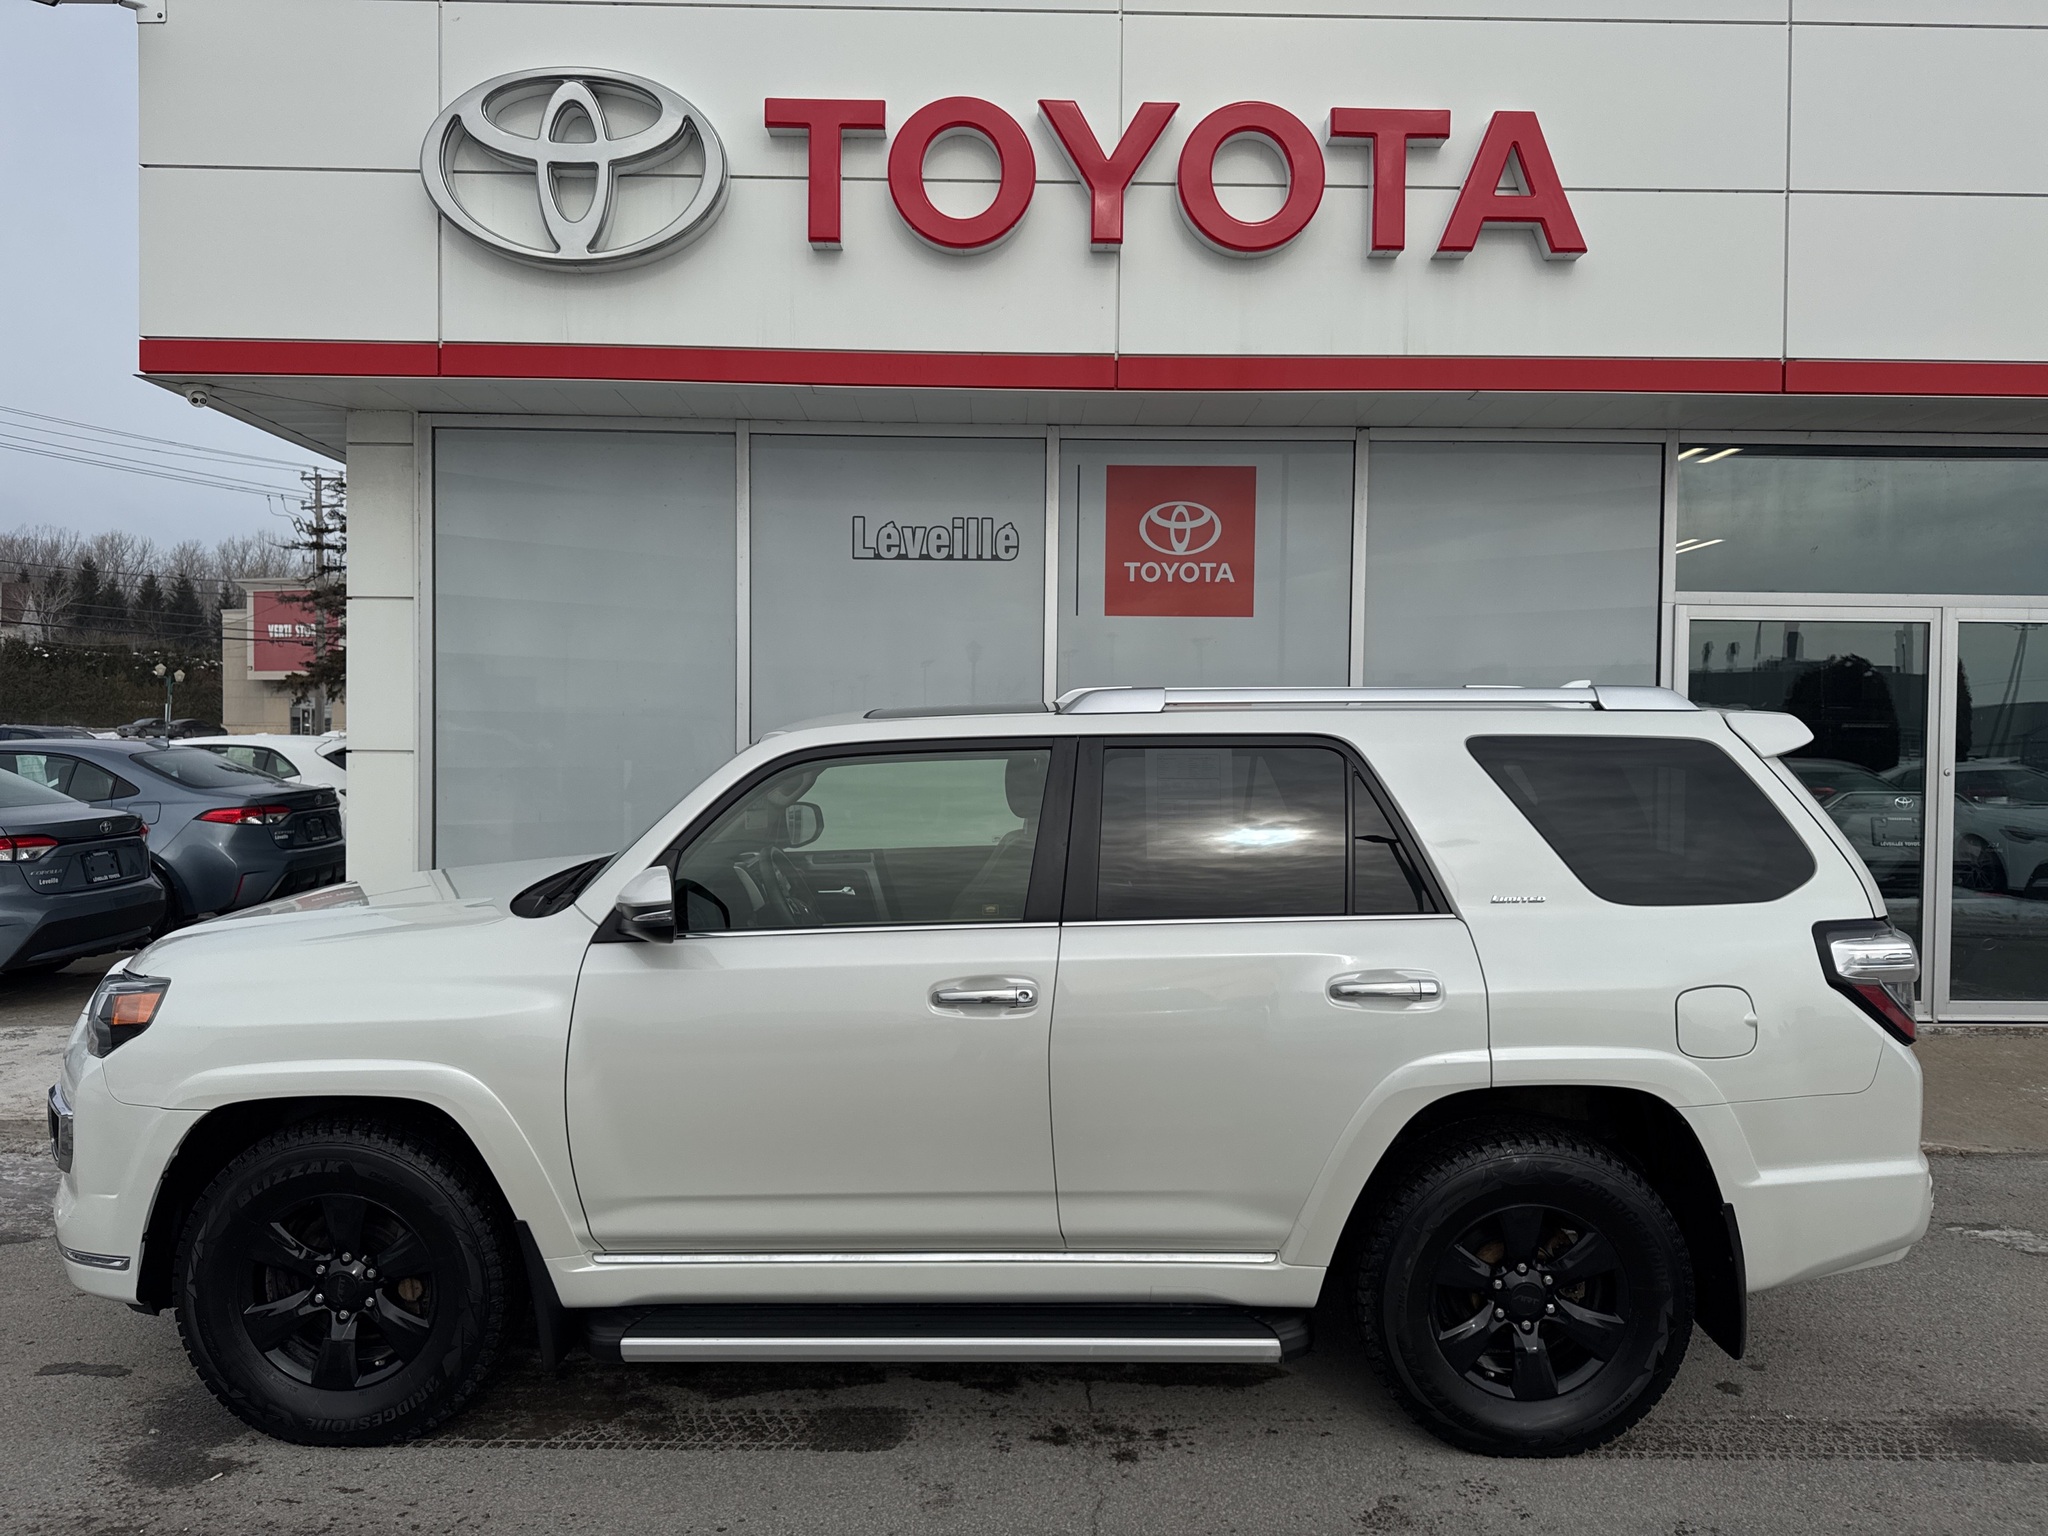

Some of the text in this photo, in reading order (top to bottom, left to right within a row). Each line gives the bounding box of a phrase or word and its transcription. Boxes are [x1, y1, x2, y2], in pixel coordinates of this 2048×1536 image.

[764, 95, 1587, 260] TOYOTA
[852, 515, 1019, 561] Léveillé
[1124, 562, 1235, 583] TOYOTA
[236, 1160, 345, 1209] BLIZZAK
